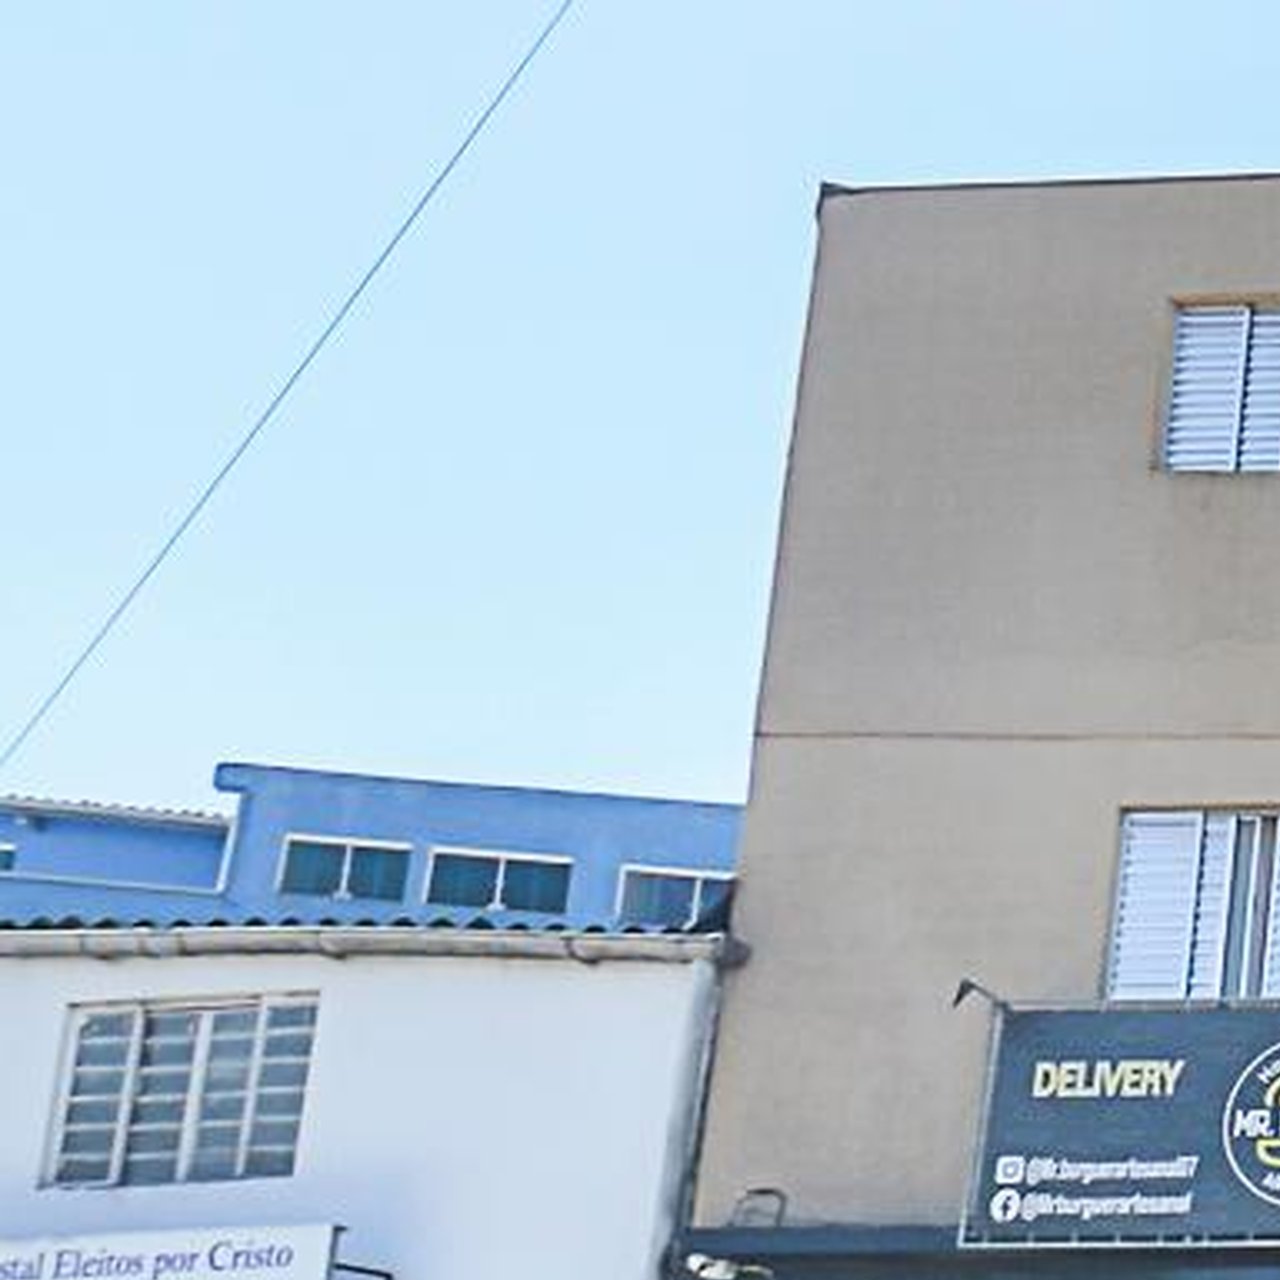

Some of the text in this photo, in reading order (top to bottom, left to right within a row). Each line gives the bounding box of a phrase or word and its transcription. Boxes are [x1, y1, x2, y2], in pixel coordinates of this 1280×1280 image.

[1032, 1059, 1185, 1098] DELIVERY
[1233, 1108, 1276, 1138] MR.
[51, 1249, 144, 1280] Eleitos
[208, 1240, 294, 1271] Cristo
